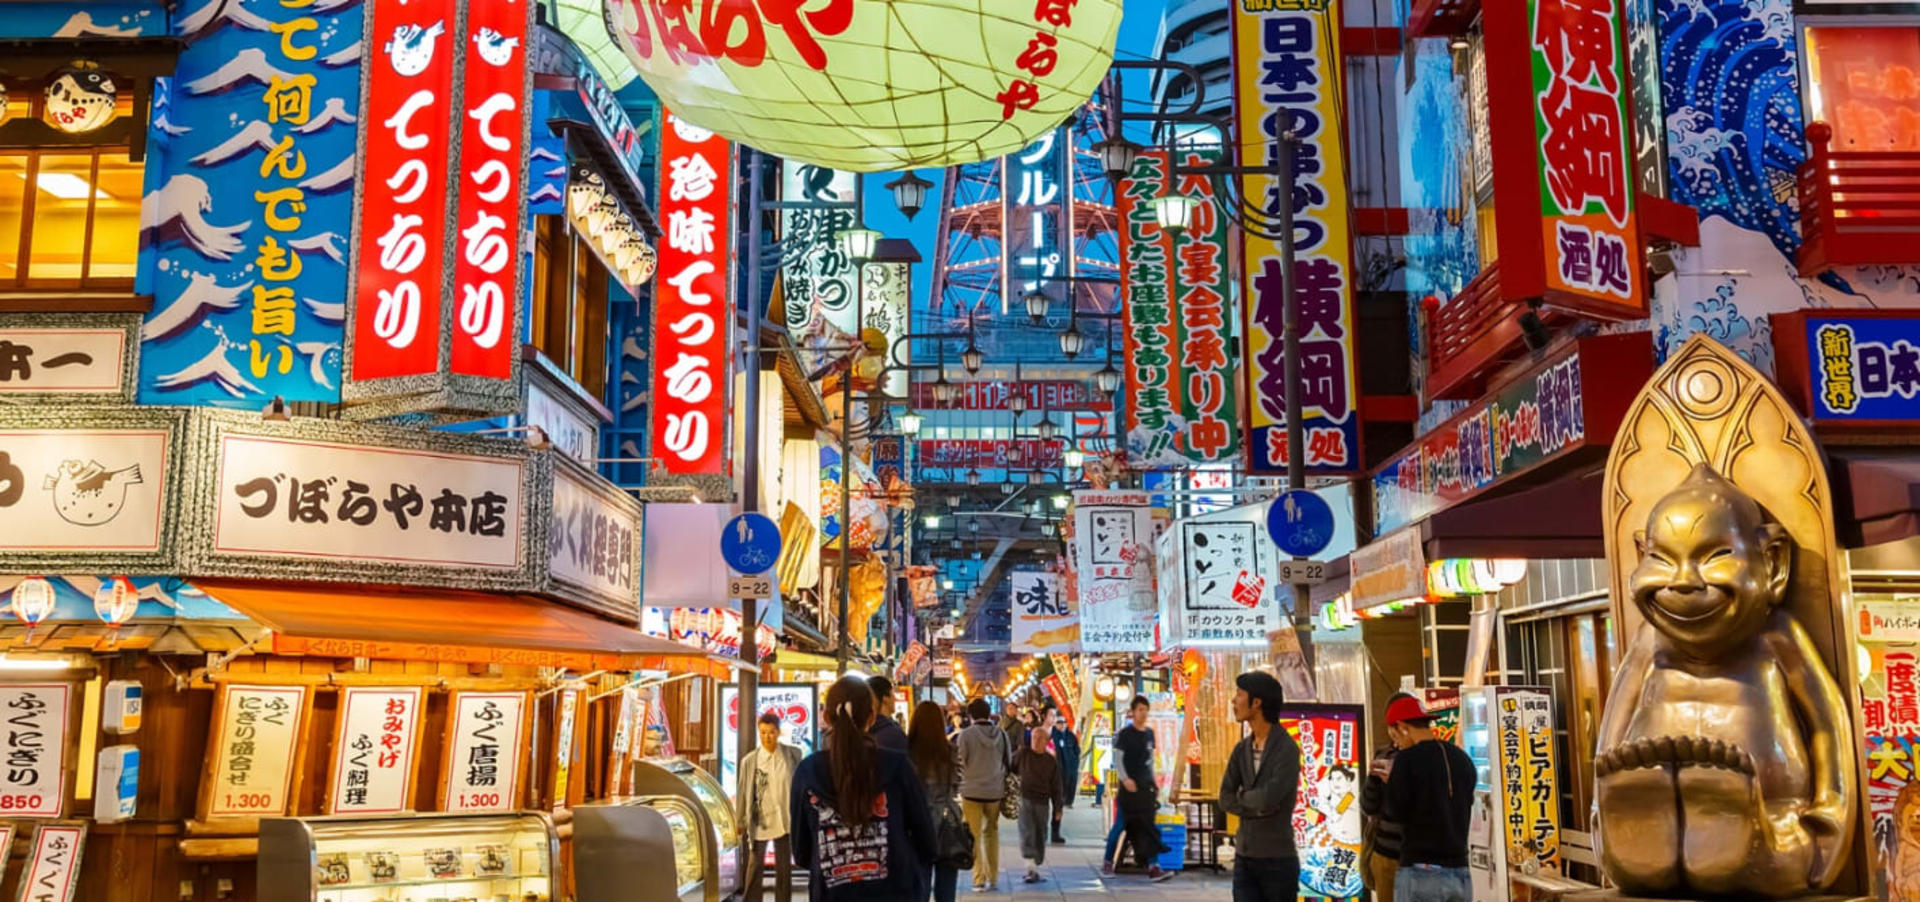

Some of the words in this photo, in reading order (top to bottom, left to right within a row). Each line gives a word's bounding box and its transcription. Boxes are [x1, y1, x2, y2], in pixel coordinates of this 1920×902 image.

[374, 89, 436, 349] てっちり
[459, 92, 516, 349] てっちり
[1557, 225, 1630, 294] 酒処
[662, 152, 718, 463] 珍味てっちり
[1820, 327, 1857, 410] 新世界
[234, 473, 508, 538] づぼらや本店
[732, 582, 769, 595] 9-22
[1282, 565, 1323, 579] 9-22
[8, 692, 46, 786] ふぐにぎり
[226, 696, 261, 786] にぎり盛合せ
[262, 697, 289, 725] ふぐ
[378, 698, 406, 768] おみやげ
[465, 700, 504, 787] ふぐ唐揚
[225, 794, 270, 808] 1,300
[344, 734, 373, 805] ふぐ料理
[458, 794, 499, 808] 1,300
